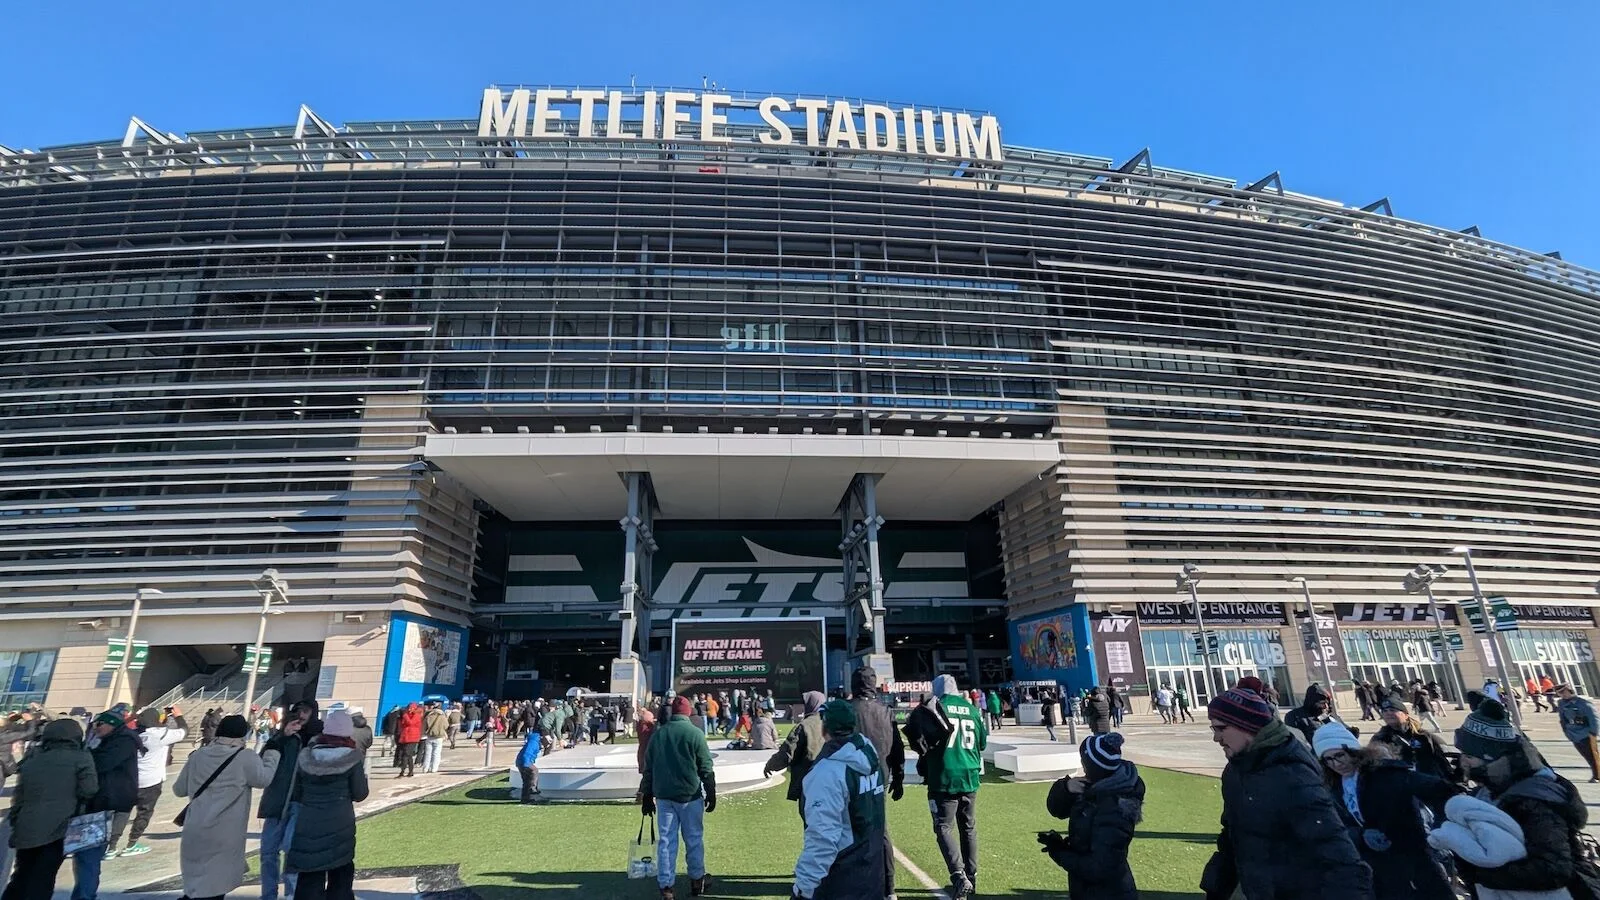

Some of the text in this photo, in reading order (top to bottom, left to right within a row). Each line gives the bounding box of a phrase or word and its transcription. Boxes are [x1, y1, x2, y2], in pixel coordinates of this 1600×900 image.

[478, 88, 1002, 161] METLIFE STADIUM
[1140, 602, 1282, 615] WEST VP ENTRANCE
[1513, 605, 1591, 617] ST VIP ENTRANCE
[1097, 618, 1133, 633] NY
[685, 638, 761, 650] MERCH ITEM
[683, 650, 763, 661] OF THE GAME
[1224, 642, 1285, 665] CLUB
[1534, 641, 1594, 661] SUITES
[711, 665, 734, 673] GREEN
[725, 677, 739, 685] Shop
[887, 681, 931, 693] SUPREM
[946, 705, 970, 715] HOLDER
[948, 717, 975, 750] 76
[859, 770, 879, 795] NY
